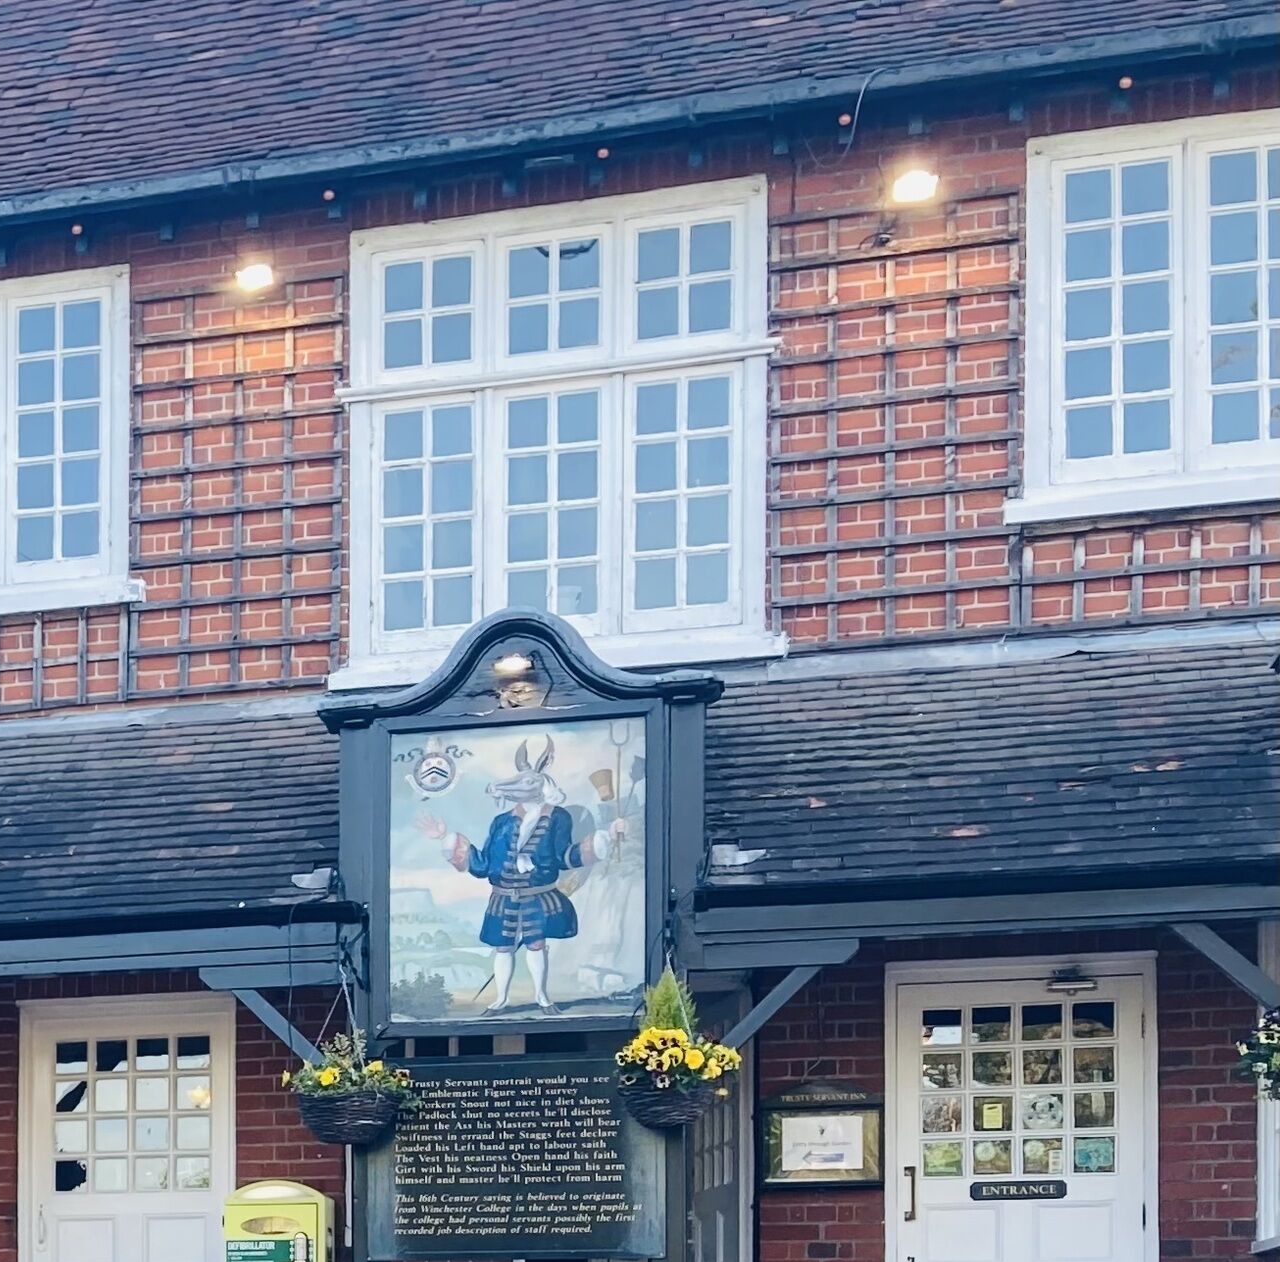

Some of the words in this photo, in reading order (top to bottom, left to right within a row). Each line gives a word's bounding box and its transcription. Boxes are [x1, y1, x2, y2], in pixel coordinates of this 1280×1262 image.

[409, 1080, 440, 1089] Trusty
[444, 1079, 488, 1087] Servants
[492, 1077, 531, 1088] portrait
[536, 1075, 566, 1084] would
[570, 1077, 588, 1085] you
[421, 1089, 479, 1099] Emblematic
[484, 1088, 516, 1098] Figure
[521, 1087, 541, 1096] well
[545, 1088, 578, 1096] survey
[419, 1100, 456, 1109] Porkers
[460, 1100, 489, 1108] Snout
[494, 1099, 510, 1107] not
[515, 1098, 536, 1107] nice
[541, 1098, 551, 1106] in
[555, 1097, 575, 1106] diet
[579, 1096, 610, 1105] shows
[419, 1110, 457, 1119] Padlock
[461, 1110, 483, 1119] shut
[504, 1110, 540, 1118] secrets
[545, 1108, 567, 1117] he'll
[570, 1107, 612, 1116] disclose
[395, 1122, 429, 1131] Patient
[434, 1121, 450, 1130] the
[454, 1121, 472, 1130] Ass
[477, 1121, 491, 1129] his
[495, 1120, 537, 1129] Masters
[541, 1119, 571, 1127] wrath
[575, 1118, 593, 1127] will
[598, 1117, 621, 1126] bear
[394, 1132, 442, 1141] Swiftness
[447, 1132, 457, 1140] in
[461, 1131, 495, 1140] errand
[498, 1131, 515, 1140] the
[519, 1130, 552, 1140] Staggs
[556, 1130, 576, 1138] feet
[580, 1129, 618, 1138] declare
[395, 1143, 431, 1153] Loaded
[435, 1142, 450, 1152] his
[454, 1142, 475, 1151] Left
[480, 1142, 505, 1151] hand
[509, 1144, 525, 1152] apt
[529, 1142, 540, 1150] to
[544, 1140, 577, 1150] labour
[581, 1140, 607, 1148] saith
[395, 1154, 414, 1163] The
[419, 1154, 440, 1163] Vest
[444, 1153, 459, 1162] his
[464, 1154, 508, 1162] neatness
[511, 1153, 540, 1162] Open
[544, 1151, 570, 1160] hand
[574, 1151, 589, 1160] his
[593, 1150, 618, 1159] faith
[395, 1165, 416, 1174] Girt
[420, 1164, 443, 1173] with
[447, 1164, 461, 1173] his
[465, 1163, 497, 1173] Sword
[501, 1163, 516, 1172] his
[520, 1162, 551, 1172] Shield
[555, 1164, 581, 1173] upon
[585, 1162, 600, 1171] his
[605, 1163, 625, 1171] arm
[395, 1175, 432, 1185] himself
[436, 1175, 455, 1184] and
[459, 1176, 494, 1184] master
[498, 1174, 520, 1183] he'll
[524, 1175, 561, 1185] protect
[566, 1174, 591, 1182] from
[595, 1173, 622, 1182] harm
[981, 1184, 1057, 1196] ENTRANCE
[395, 1194, 415, 1203] This
[418, 1194, 437, 1203] 16th
[440, 1194, 479, 1203] Century
[515, 1193, 523, 1201] is
[527, 1192, 566, 1201] believed
[569, 1192, 579, 1200] to
[582, 1192, 626, 1201] originate
[394, 1205, 416, 1214] from
[420, 1204, 473, 1213] Winchester
[476, 1204, 512, 1214] College
[515, 1203, 525, 1212] in
[528, 1203, 544, 1212] the
[547, 1203, 568, 1213] days
[572, 1202, 597, 1211] when
[600, 1202, 629, 1212] pupils
[394, 1216, 410, 1224] the
[412, 1215, 445, 1225] college
[448, 1215, 466, 1224] had
[468, 1214, 509, 1225] personal
[512, 1215, 551, 1223] servants
[554, 1213, 593, 1224] possibly
[596, 1213, 611, 1222] the
[615, 1213, 636, 1222] first
[394, 1226, 434, 1235] recorded
[437, 1226, 452, 1236] job
[455, 1226, 507, 1235] description
[510, 1225, 522, 1234] of
[524, 1224, 548, 1233] staff
[551, 1224, 593, 1234] required.
